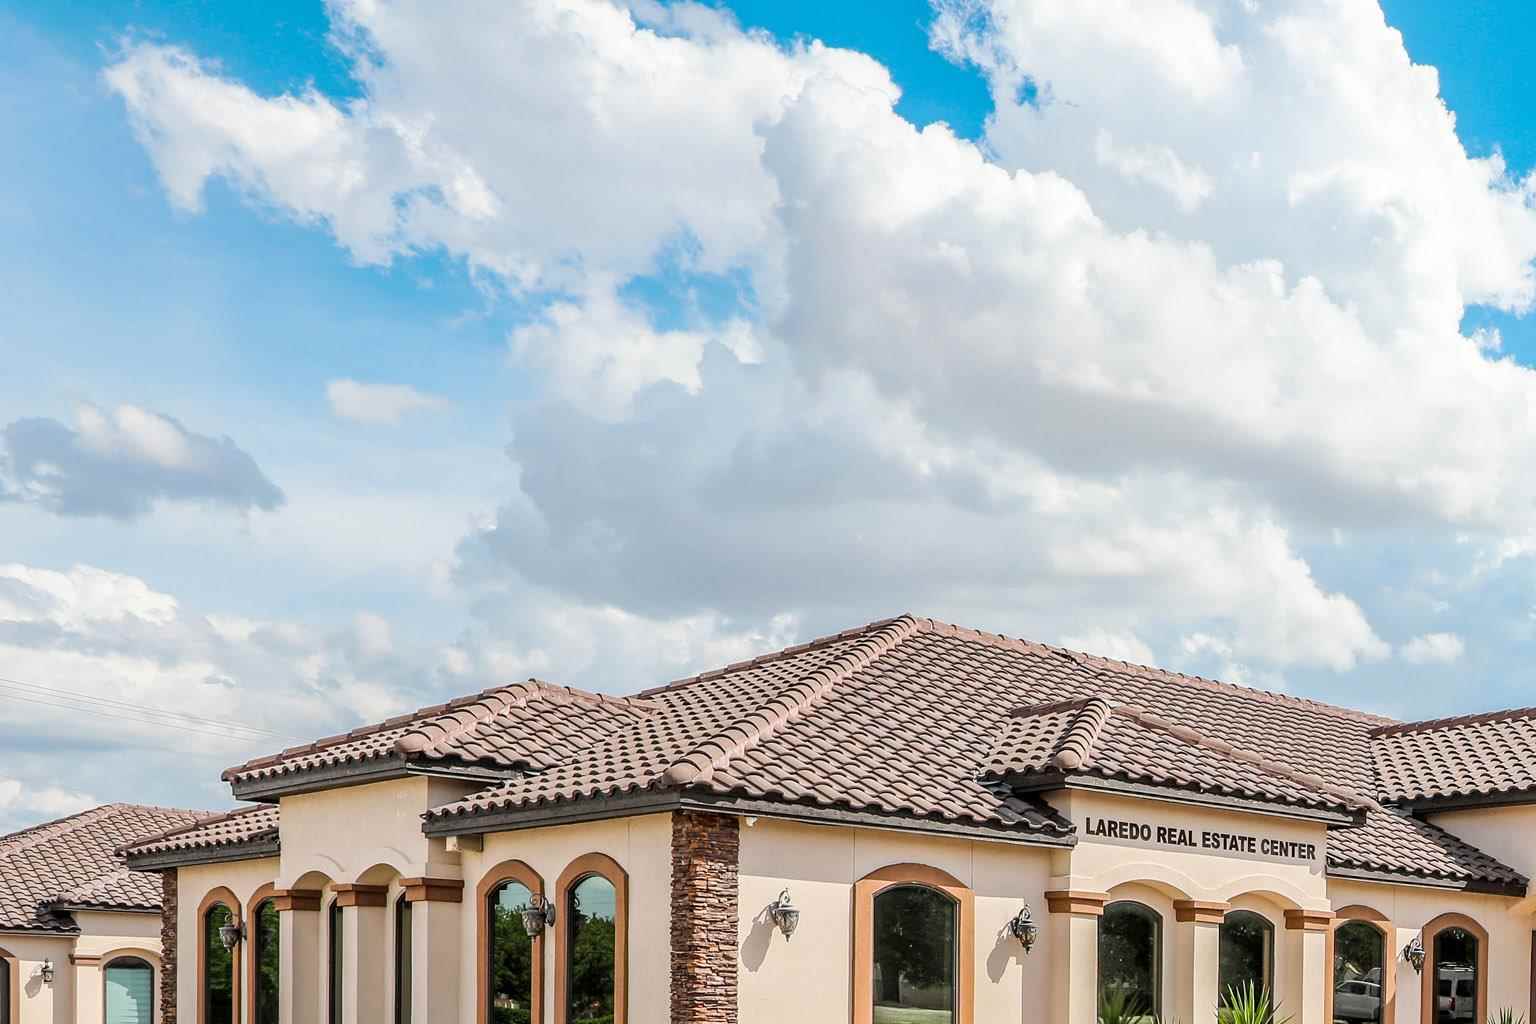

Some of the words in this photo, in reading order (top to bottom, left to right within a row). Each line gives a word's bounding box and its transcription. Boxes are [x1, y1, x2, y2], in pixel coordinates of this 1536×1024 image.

[1085, 817, 1151, 842] LAREDO
[1156, 826, 1198, 848] REAL
[1201, 831, 1257, 854] ESTATE
[1260, 838, 1316, 860] CENTER
